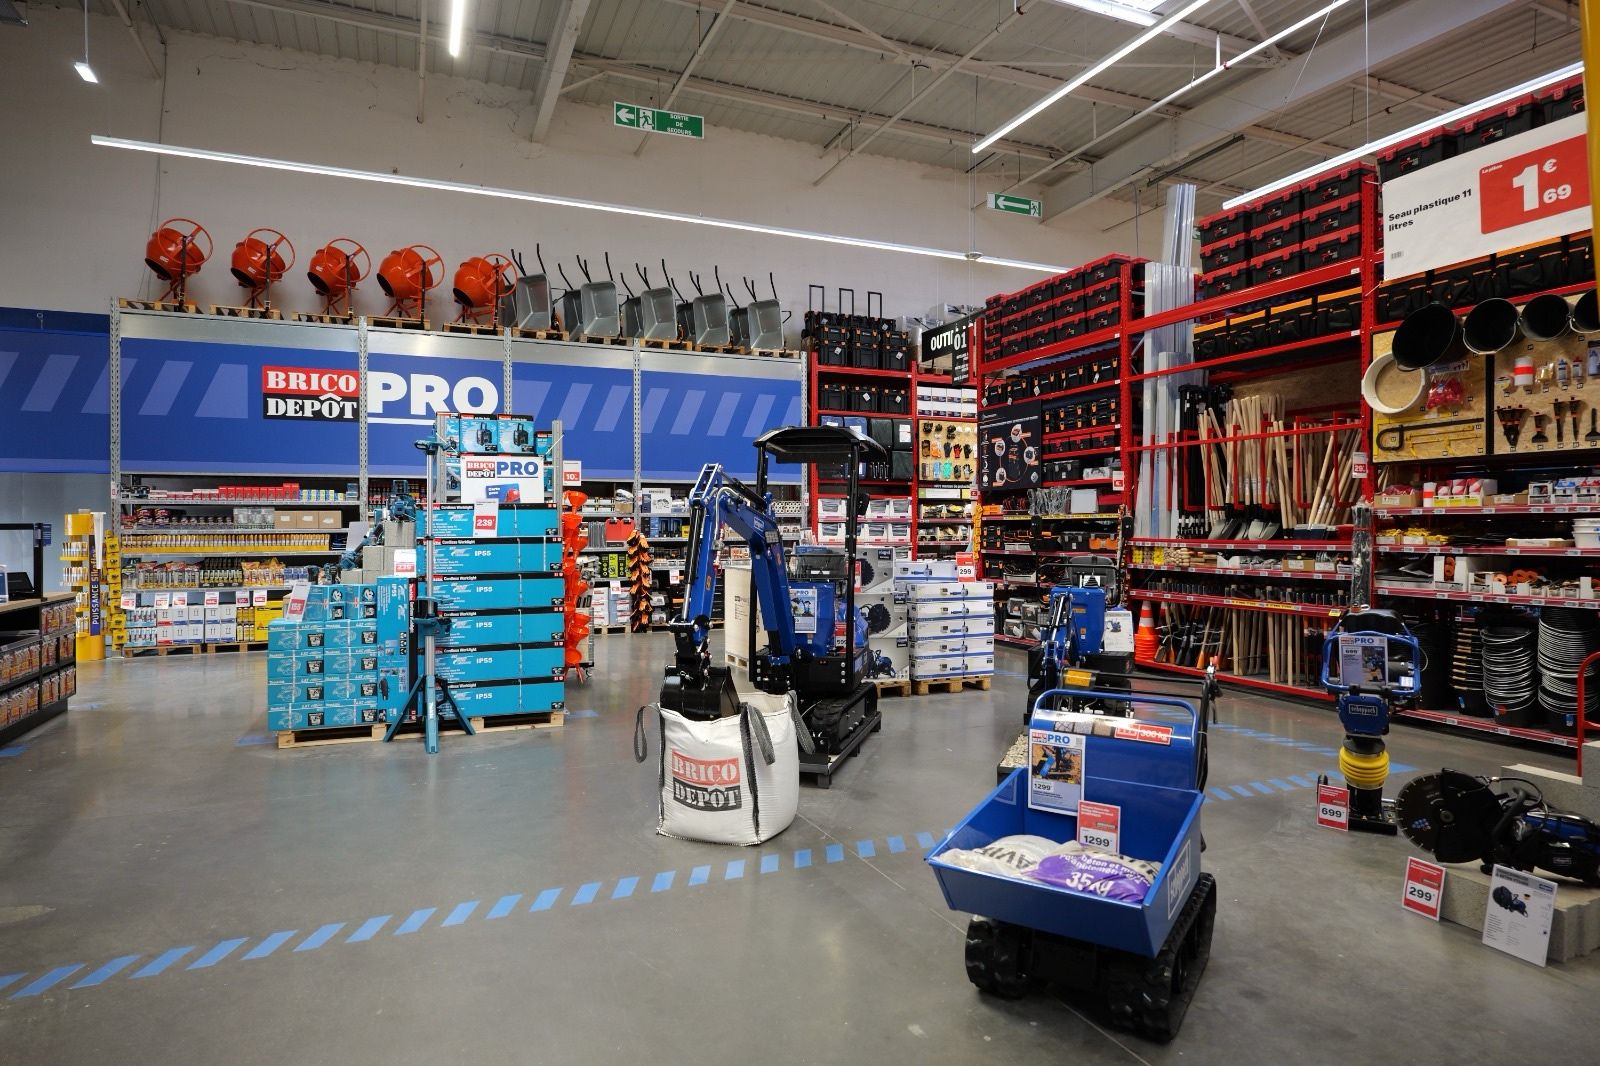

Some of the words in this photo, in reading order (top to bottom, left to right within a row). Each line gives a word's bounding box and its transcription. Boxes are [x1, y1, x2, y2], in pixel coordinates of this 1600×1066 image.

[666, 127, 692, 136] SECOURS
[1542, 158, 1558, 173] €
[1512, 163, 1540, 213] 1
[1542, 183, 1572, 204] 69
[1388, 209, 1412, 222] Seau
[1413, 194, 1461, 216] plastique
[1462, 188, 1472, 198] 11
[1388, 219, 1414, 232] litres
[953, 331, 967, 351] 01
[266, 370, 358, 393] BRICO
[367, 371, 499, 416] PRO
[266, 392, 358, 419] DEPÔT
[466, 461, 495, 470] BRICO
[466, 468, 495, 478] DEPÔT
[496, 461, 539, 476] PRO
[476, 519, 493, 527] 239
[91, 584, 99, 625] PUISSANCE
[475, 692, 493, 700] IP55
[1048, 734, 1071, 744] PRO
[672, 755, 738, 782] BRICO
[674, 781, 739, 809] DEPÔT
[1321, 807, 1342, 818] 699
[1083, 835, 1110, 847] 1299
[1408, 886, 1432, 902] 299
